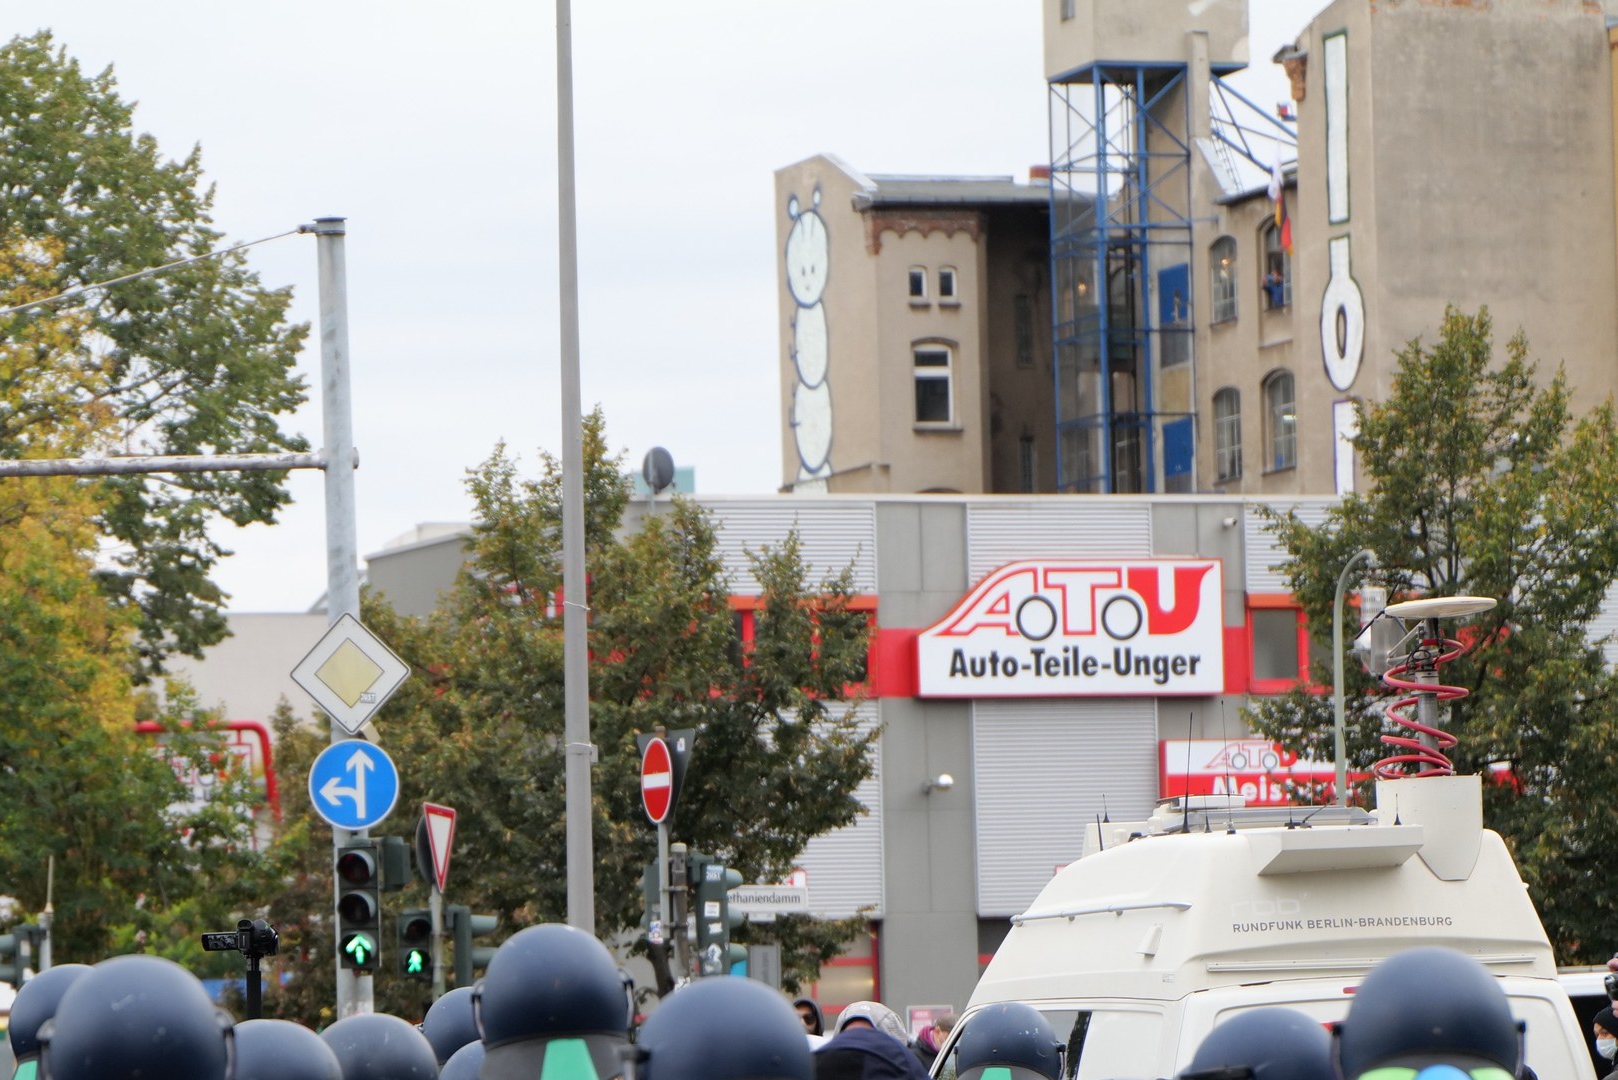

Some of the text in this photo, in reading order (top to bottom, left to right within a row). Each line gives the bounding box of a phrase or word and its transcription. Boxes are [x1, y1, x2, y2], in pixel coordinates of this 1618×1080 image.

[949, 645, 1201, 685] Auto-Teile-Unger
[728, 891, 801, 904] ethaniendamm
[1233, 916, 1453, 933] RUNDFUNK BERLIN-BRANDENBURG
